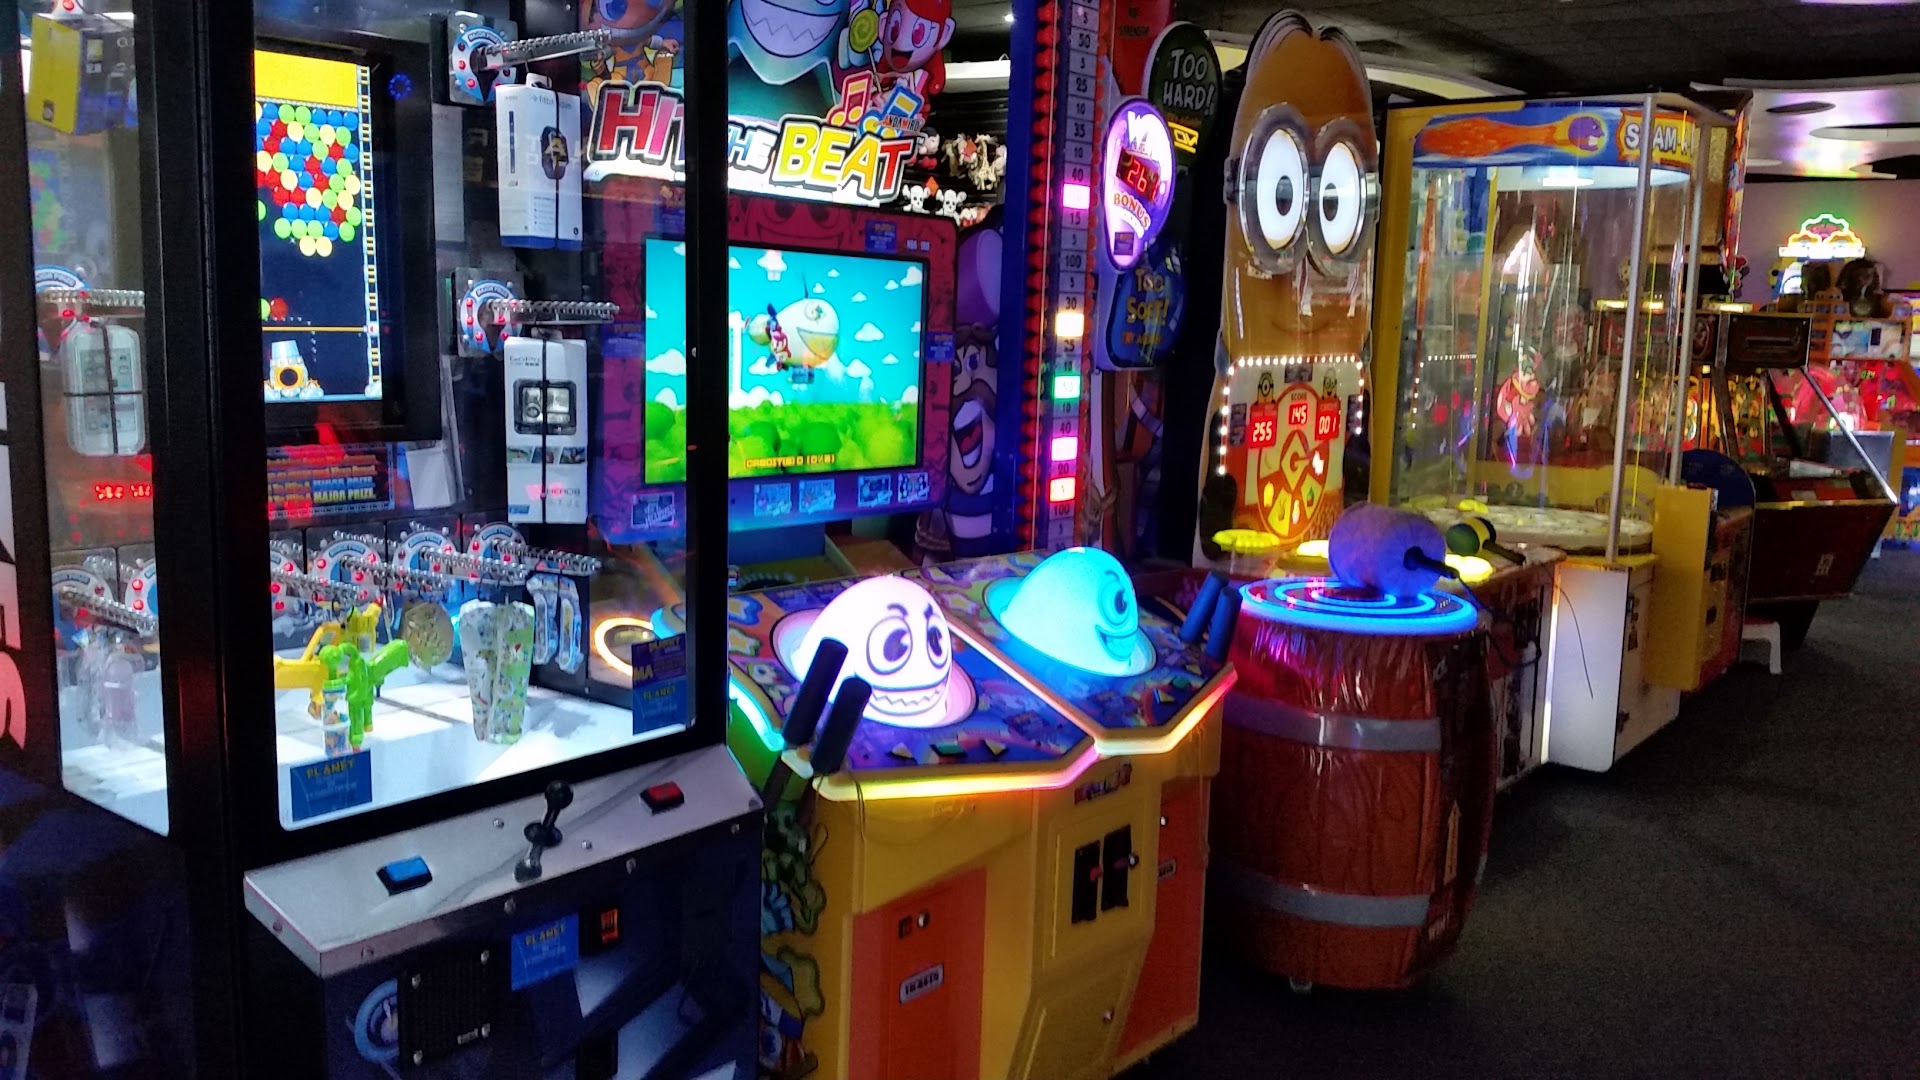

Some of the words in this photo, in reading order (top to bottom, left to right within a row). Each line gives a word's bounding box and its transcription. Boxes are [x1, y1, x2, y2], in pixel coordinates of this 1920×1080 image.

[1078, 33, 1091, 49] 50
[1080, 57, 1086, 69] 5
[1170, 48, 1208, 81] TOO
[1076, 77, 1088, 93] 25
[1163, 81, 1216, 116] HARD!
[1076, 103, 1086, 115] 10
[881, 114, 920, 131] ANDAMIRO
[1074, 122, 1086, 138] 35
[774, 120, 915, 198] BEAT
[1074, 147, 1084, 158] 10
[1072, 168, 1084, 182] 40
[1070, 212, 1081, 225] 15
[1113, 193, 1151, 231] BONUS
[1065, 254, 1082, 268] 100
[1065, 297, 1077, 310] 30
[1062, 402, 1071, 413] 10
[1291, 405, 1307, 425] 145
[1060, 421, 1071, 434] 40
[1252, 421, 1273, 443] 255
[1318, 415, 1337, 435] 001
[313, 489, 346, 504] MAJOR
[1054, 503, 1070, 516] 100
[644, 685, 676, 700] PLANET
[306, 757, 356, 780] PLANET
[525, 923, 565, 945] PLANET
